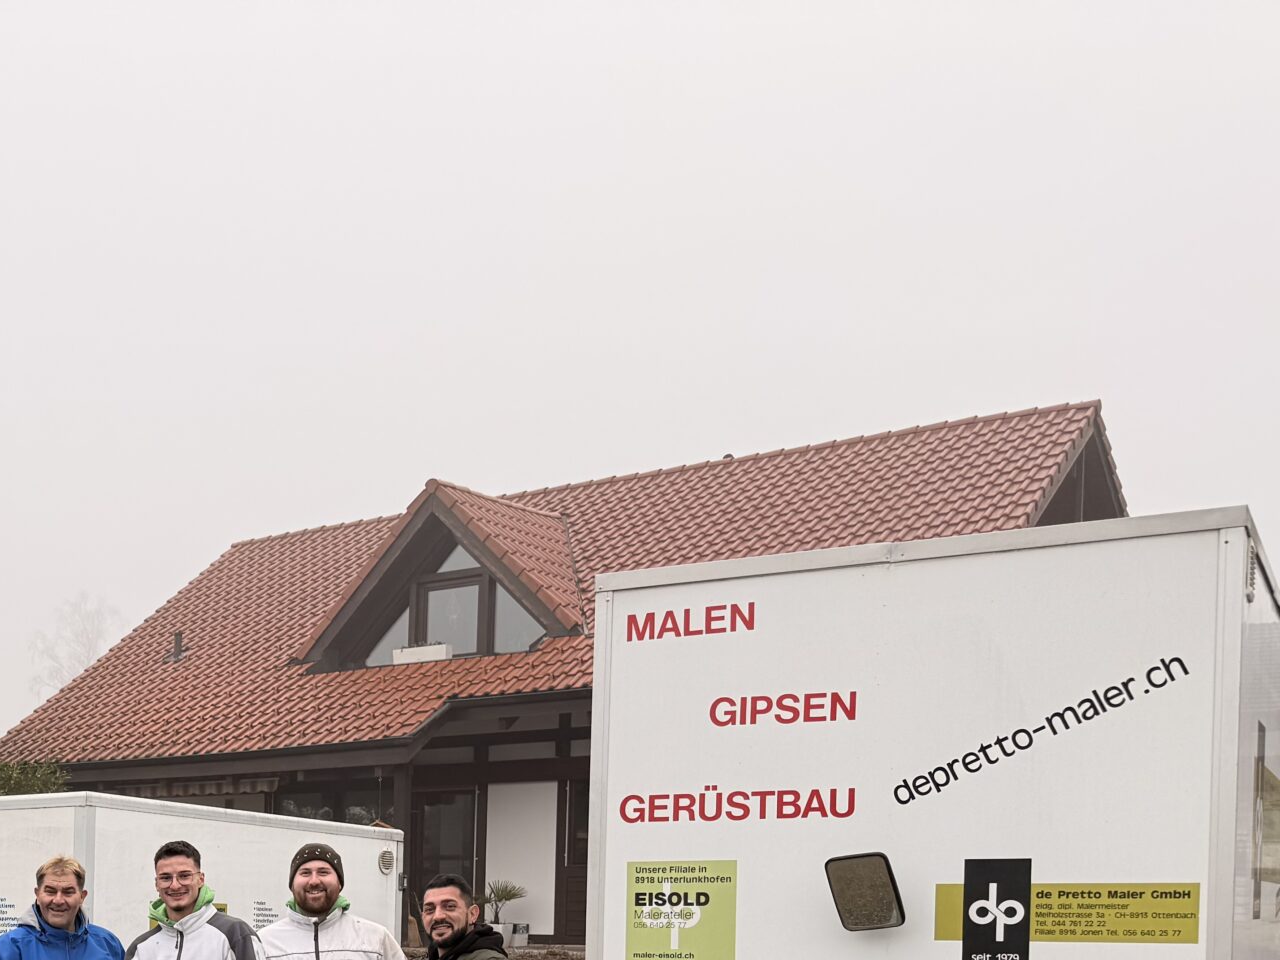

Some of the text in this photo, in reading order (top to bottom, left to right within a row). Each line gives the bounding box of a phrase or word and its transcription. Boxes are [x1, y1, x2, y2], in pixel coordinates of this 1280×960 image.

[626, 601, 756, 642] MALEN
[709, 691, 857, 727] GIPSEN
[893, 655, 1190, 806] depretto-maler.ch
[619, 785, 856, 824] GERÜSTBAU
[635, 865, 707, 874] Unsere Filiale in
[635, 875, 732, 884] 8918 Unterlunkhofen
[634, 892, 710, 906] EISOLD
[1036, 890, 1191, 899] de Pretto Maler GmbH
[634, 909, 695, 920] Maleratelier
[1151, 911, 1196, 919] Ottenbach
[1034, 928, 1056, 936] Filiale
[1106, 929, 1119, 937] Tel.
[1122, 929, 1138, 937] 056
[1159, 929, 1169, 937] 25
[1172, 929, 1182, 937] 77
